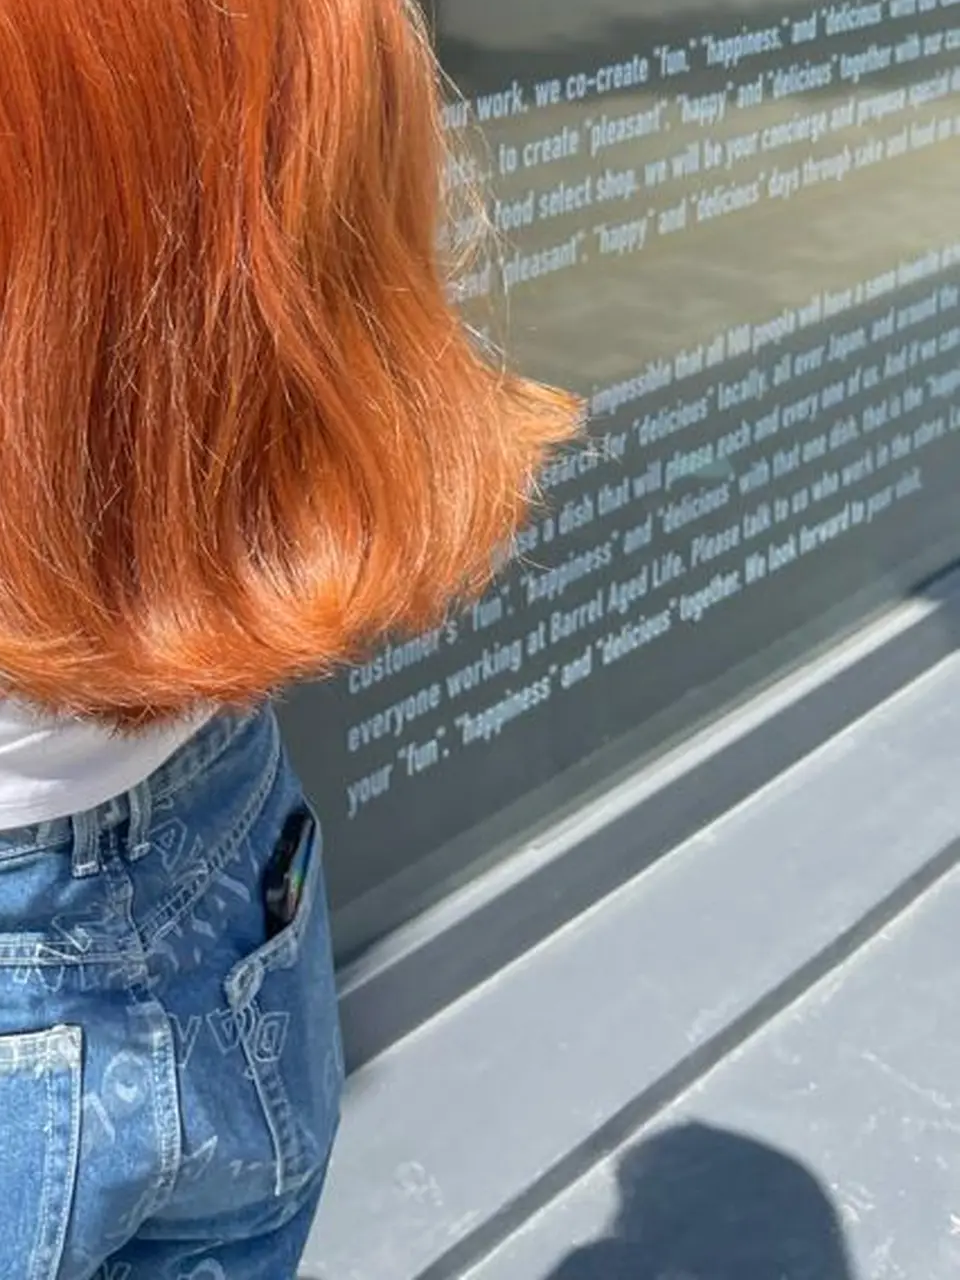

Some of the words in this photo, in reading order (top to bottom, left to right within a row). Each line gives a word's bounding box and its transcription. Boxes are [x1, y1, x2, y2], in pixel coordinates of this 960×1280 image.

[535, 77, 560, 107] we
[566, 55, 648, 99] co-create
[792, 9, 817, 45] and
[498, 144, 517, 174] to
[523, 127, 580, 167] create
[737, 73, 763, 109] and
[539, 175, 592, 219] select
[644, 159, 667, 187] we
[724, 131, 759, 171] your
[829, 97, 856, 131] and
[658, 197, 687, 235] and
[558, 494, 593, 535] dish
[597, 476, 630, 515] that
[753, 403, 780, 443] and
[623, 511, 653, 555] and
[348, 682, 442, 752] everyone
[445, 639, 523, 699] working
[526, 619, 547, 656] at
[550, 587, 604, 644] Barrel
[607, 563, 649, 615] Aged
[690, 523, 740, 569] Please
[742, 501, 773, 540] talk
[346, 763, 393, 820] your
[560, 644, 593, 690] and
